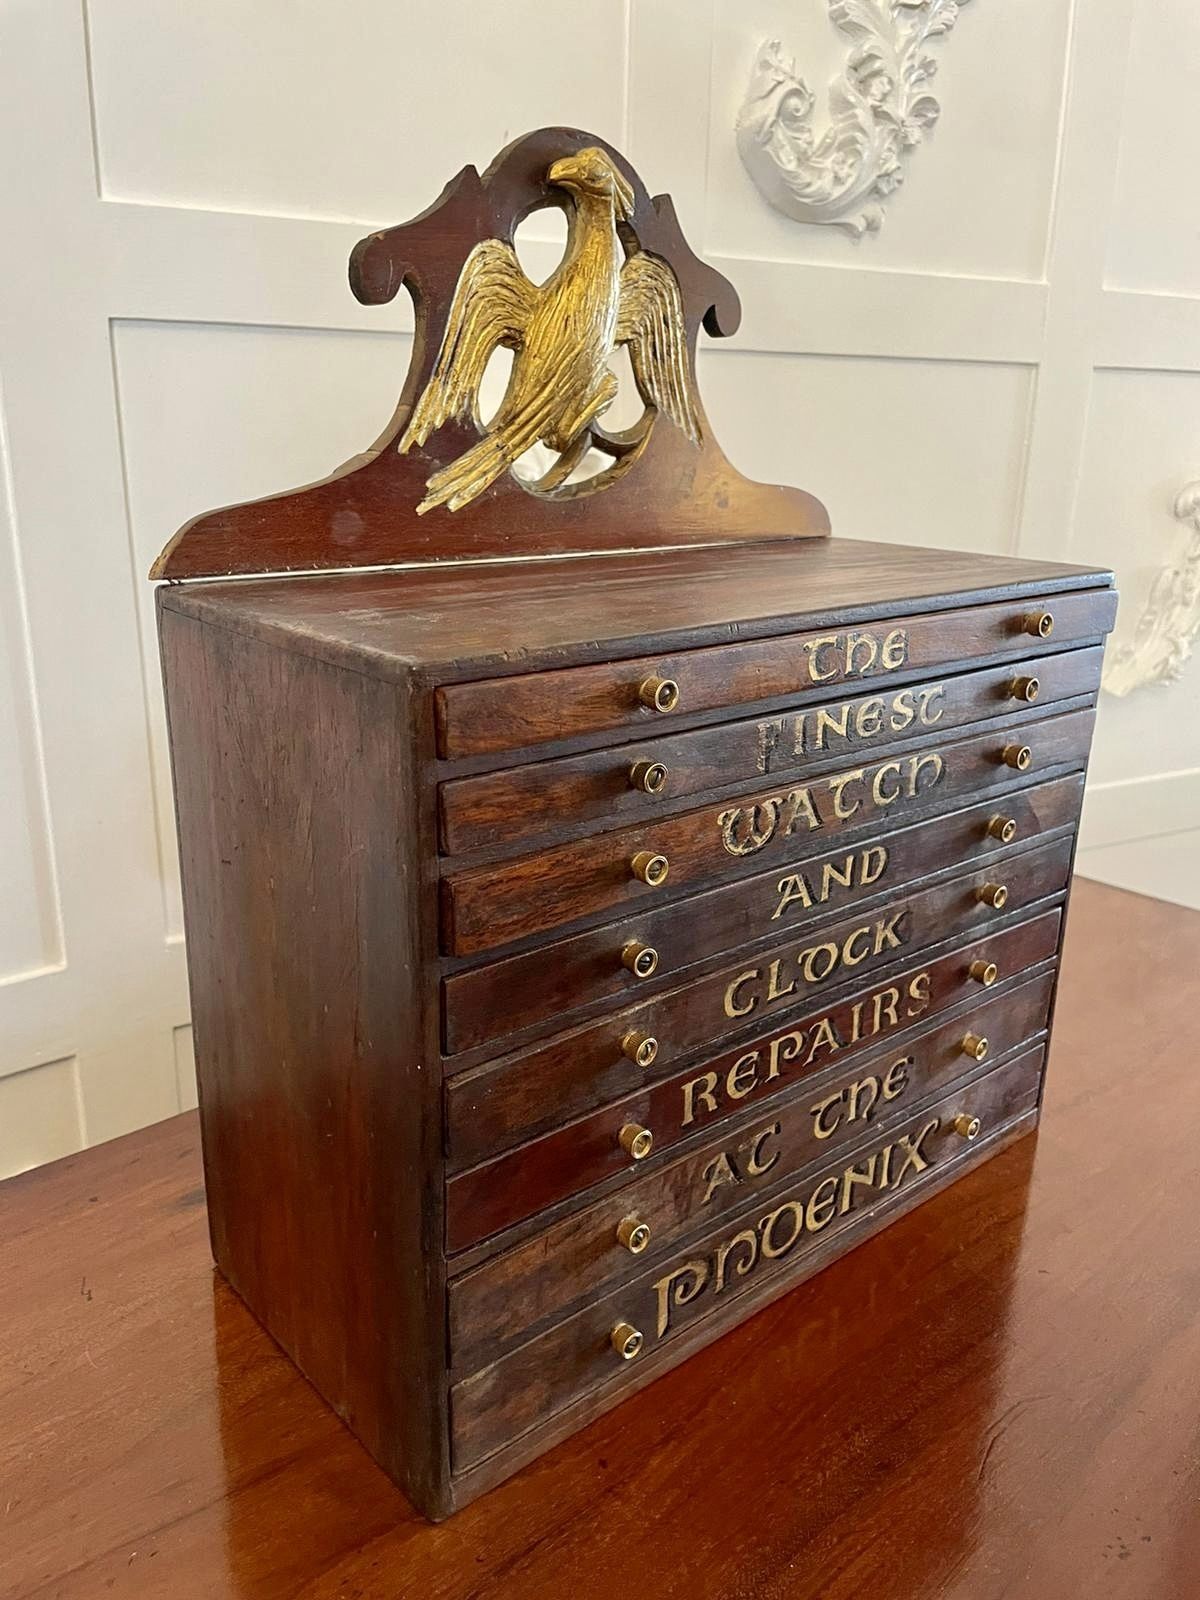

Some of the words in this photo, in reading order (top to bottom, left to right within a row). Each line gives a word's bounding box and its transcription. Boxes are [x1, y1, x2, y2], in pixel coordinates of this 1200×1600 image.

[755, 685, 946, 774] FINEST
[771, 845, 889, 921] AND
[723, 911, 909, 1019] CLOCK
[680, 971, 933, 1128] REPAIRS
